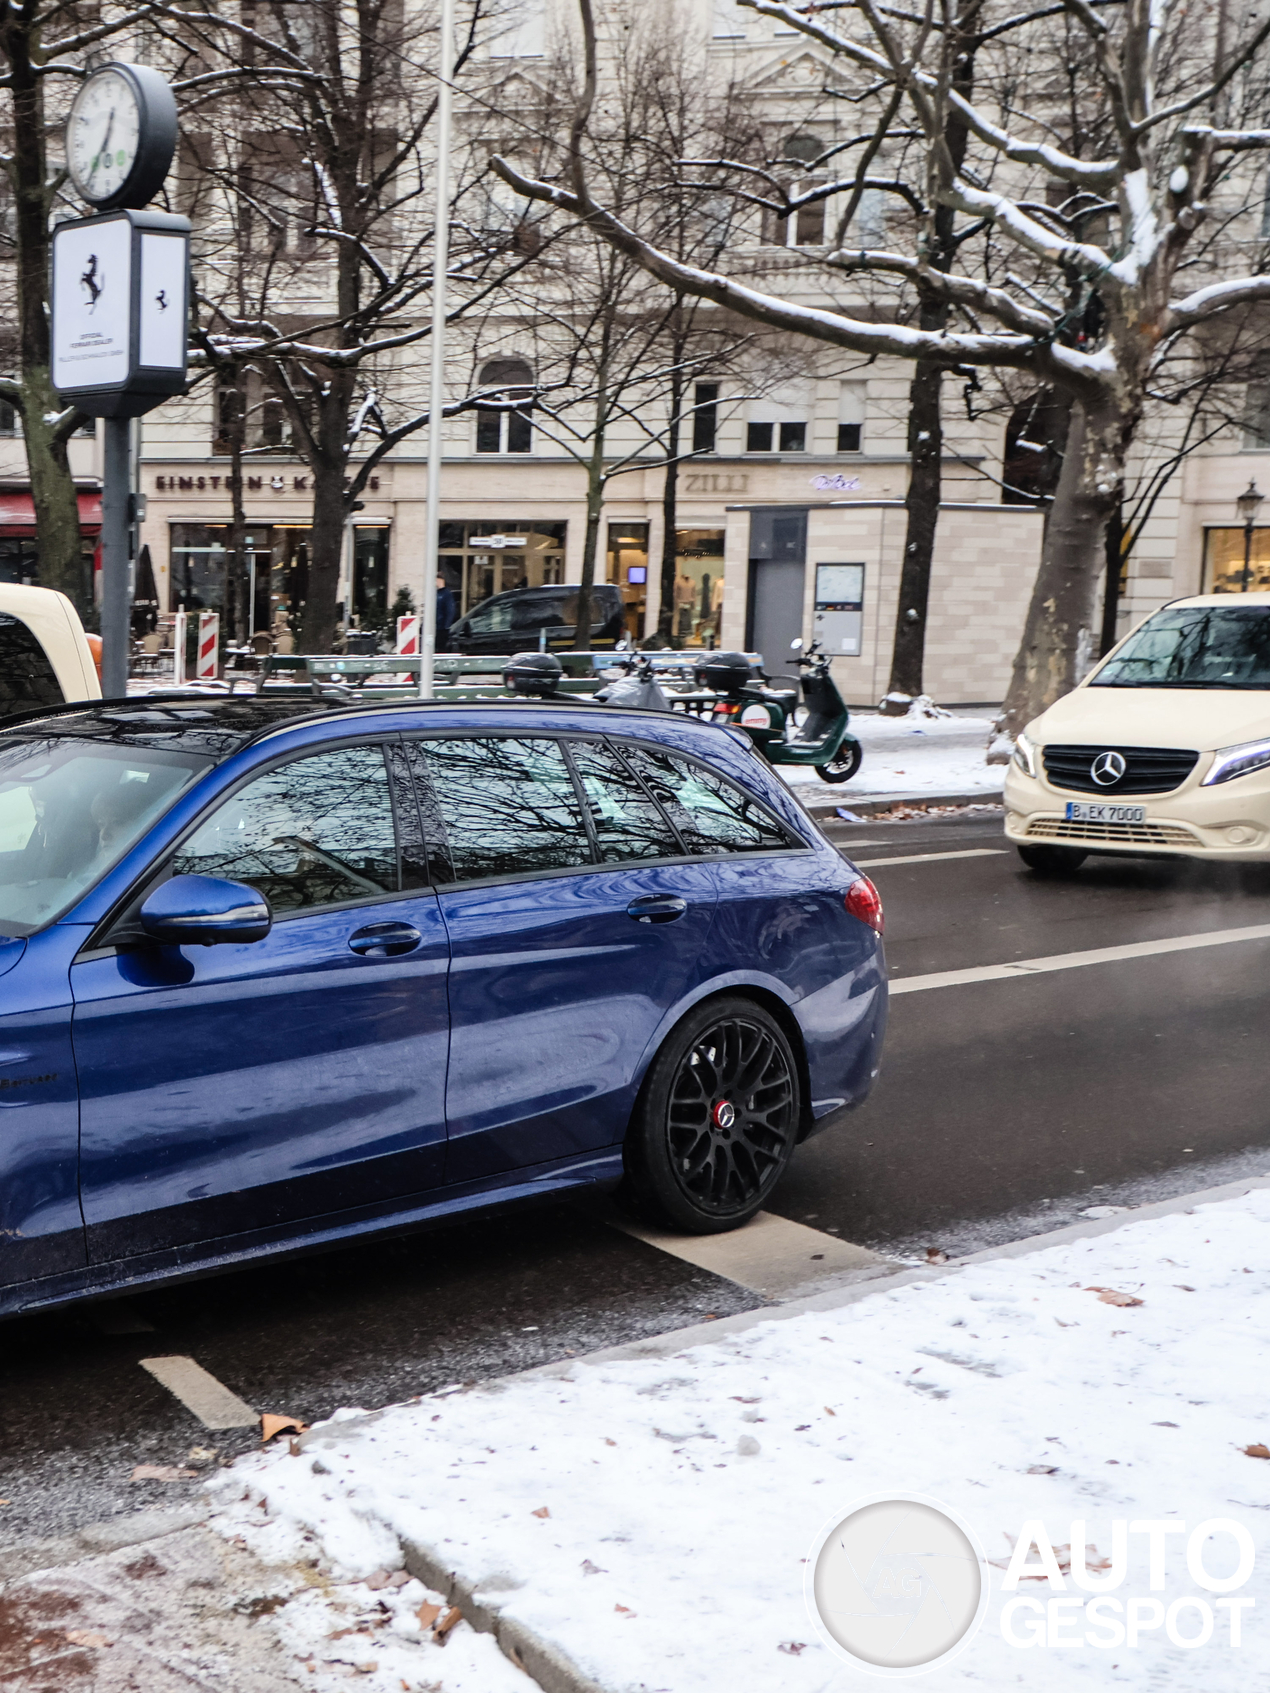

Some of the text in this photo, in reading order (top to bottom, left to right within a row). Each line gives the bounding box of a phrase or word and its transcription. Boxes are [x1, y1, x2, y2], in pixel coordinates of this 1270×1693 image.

[155, 476, 262, 490] EINSTEN
[1073, 804, 1143, 821] B EK 7000
